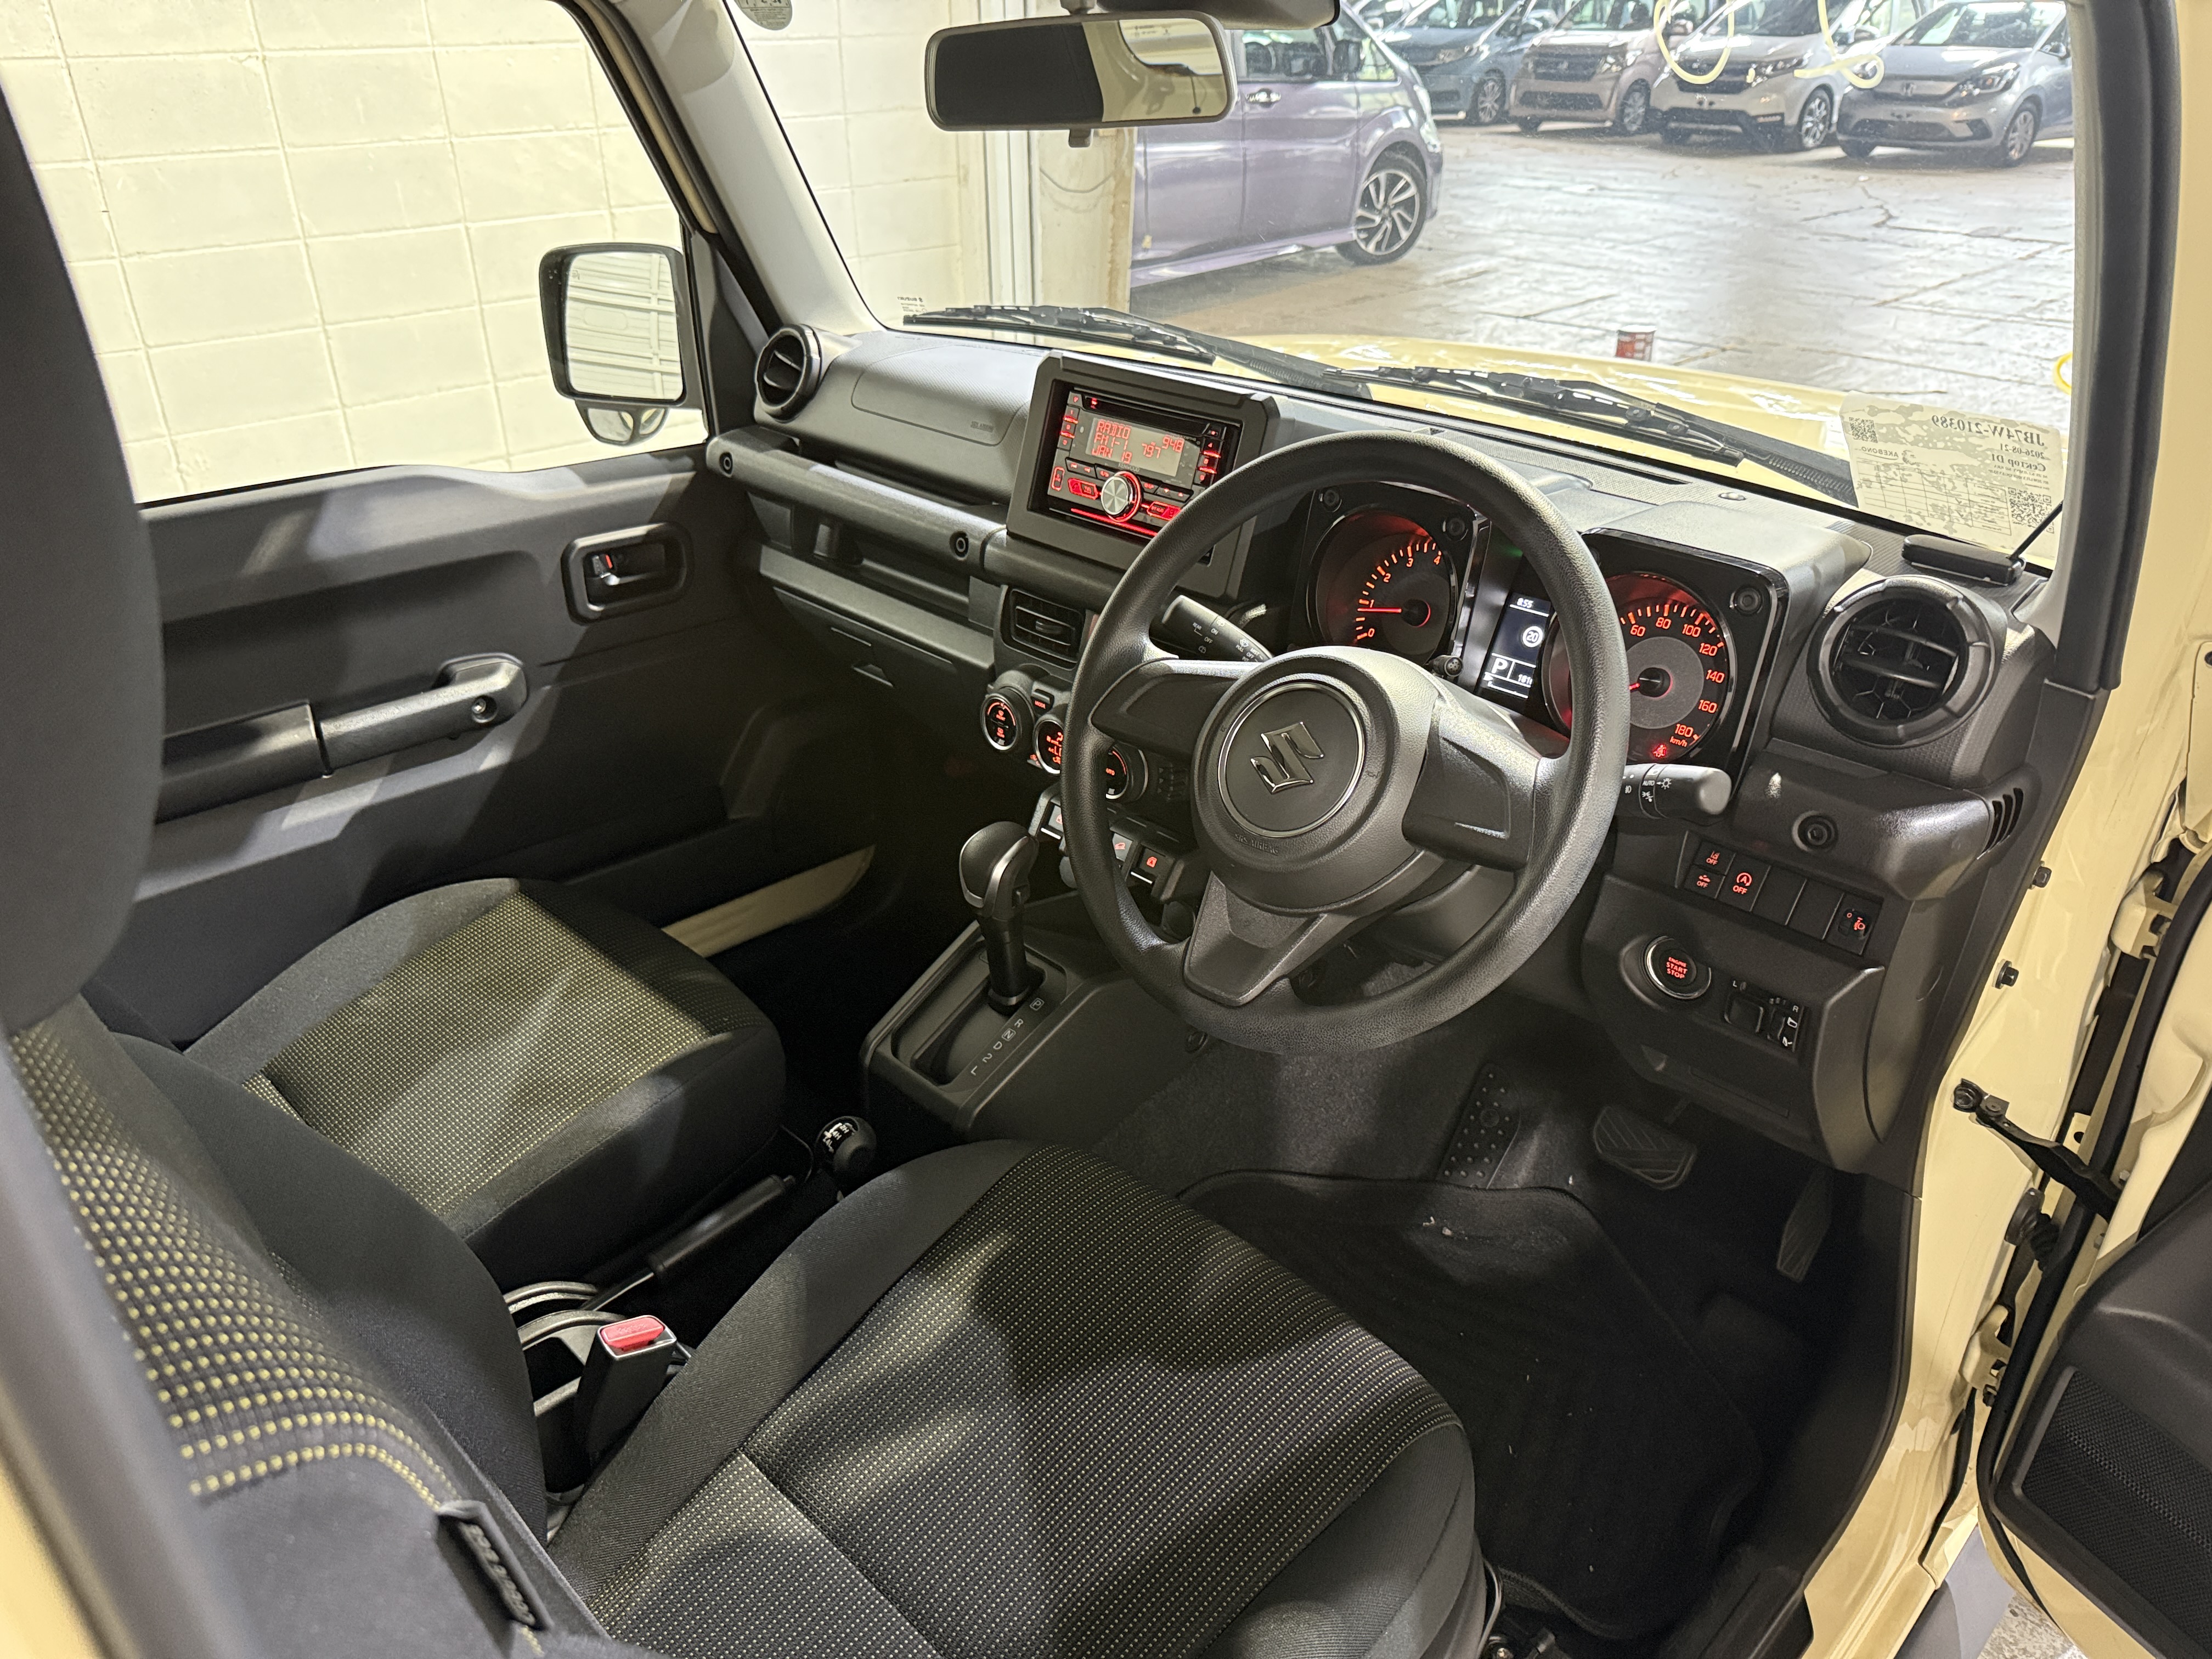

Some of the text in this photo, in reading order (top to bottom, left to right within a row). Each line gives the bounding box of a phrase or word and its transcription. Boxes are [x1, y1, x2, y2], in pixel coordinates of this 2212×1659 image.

[1096, 420, 1131, 440] RADIO
[1091, 445, 1132, 464] JAN 19
[1406, 558, 1413, 567] 3
[1433, 556, 1441, 565] 4
[1383, 573, 1391, 583] 2
[1369, 599, 1375, 608] 1
[1655, 617, 1672, 629] 80
[1368, 628, 1375, 637] 0
[1630, 625, 1646, 637] 60
[1682, 624, 1701, 637] 100
[1526, 631, 1539, 643] 20
[1699, 642, 1718, 656] 120
[1491, 657, 1508, 674] P
[1706, 669, 1725, 684] 140
[1698, 699, 1717, 714] 160
[1674, 724, 1694, 737] 180
[1669, 736, 1688, 747] km/h
[1105, 768, 1115, 776] UTO
[1733, 885, 1748, 895] OFF
[1668, 957, 1687, 967] ENGINE
[1666, 962, 1688, 974] START
[1667, 968, 1685, 979] STOP
[1032, 1000, 1042, 1008] P
[1792, 1005, 1799, 1013] R
[1014, 1018, 1024, 1028] R
[1004, 1030, 1014, 1040] N
[993, 1041, 1003, 1050] D
[982, 1053, 992, 1063] 2
[970, 1065, 978, 1076] L
